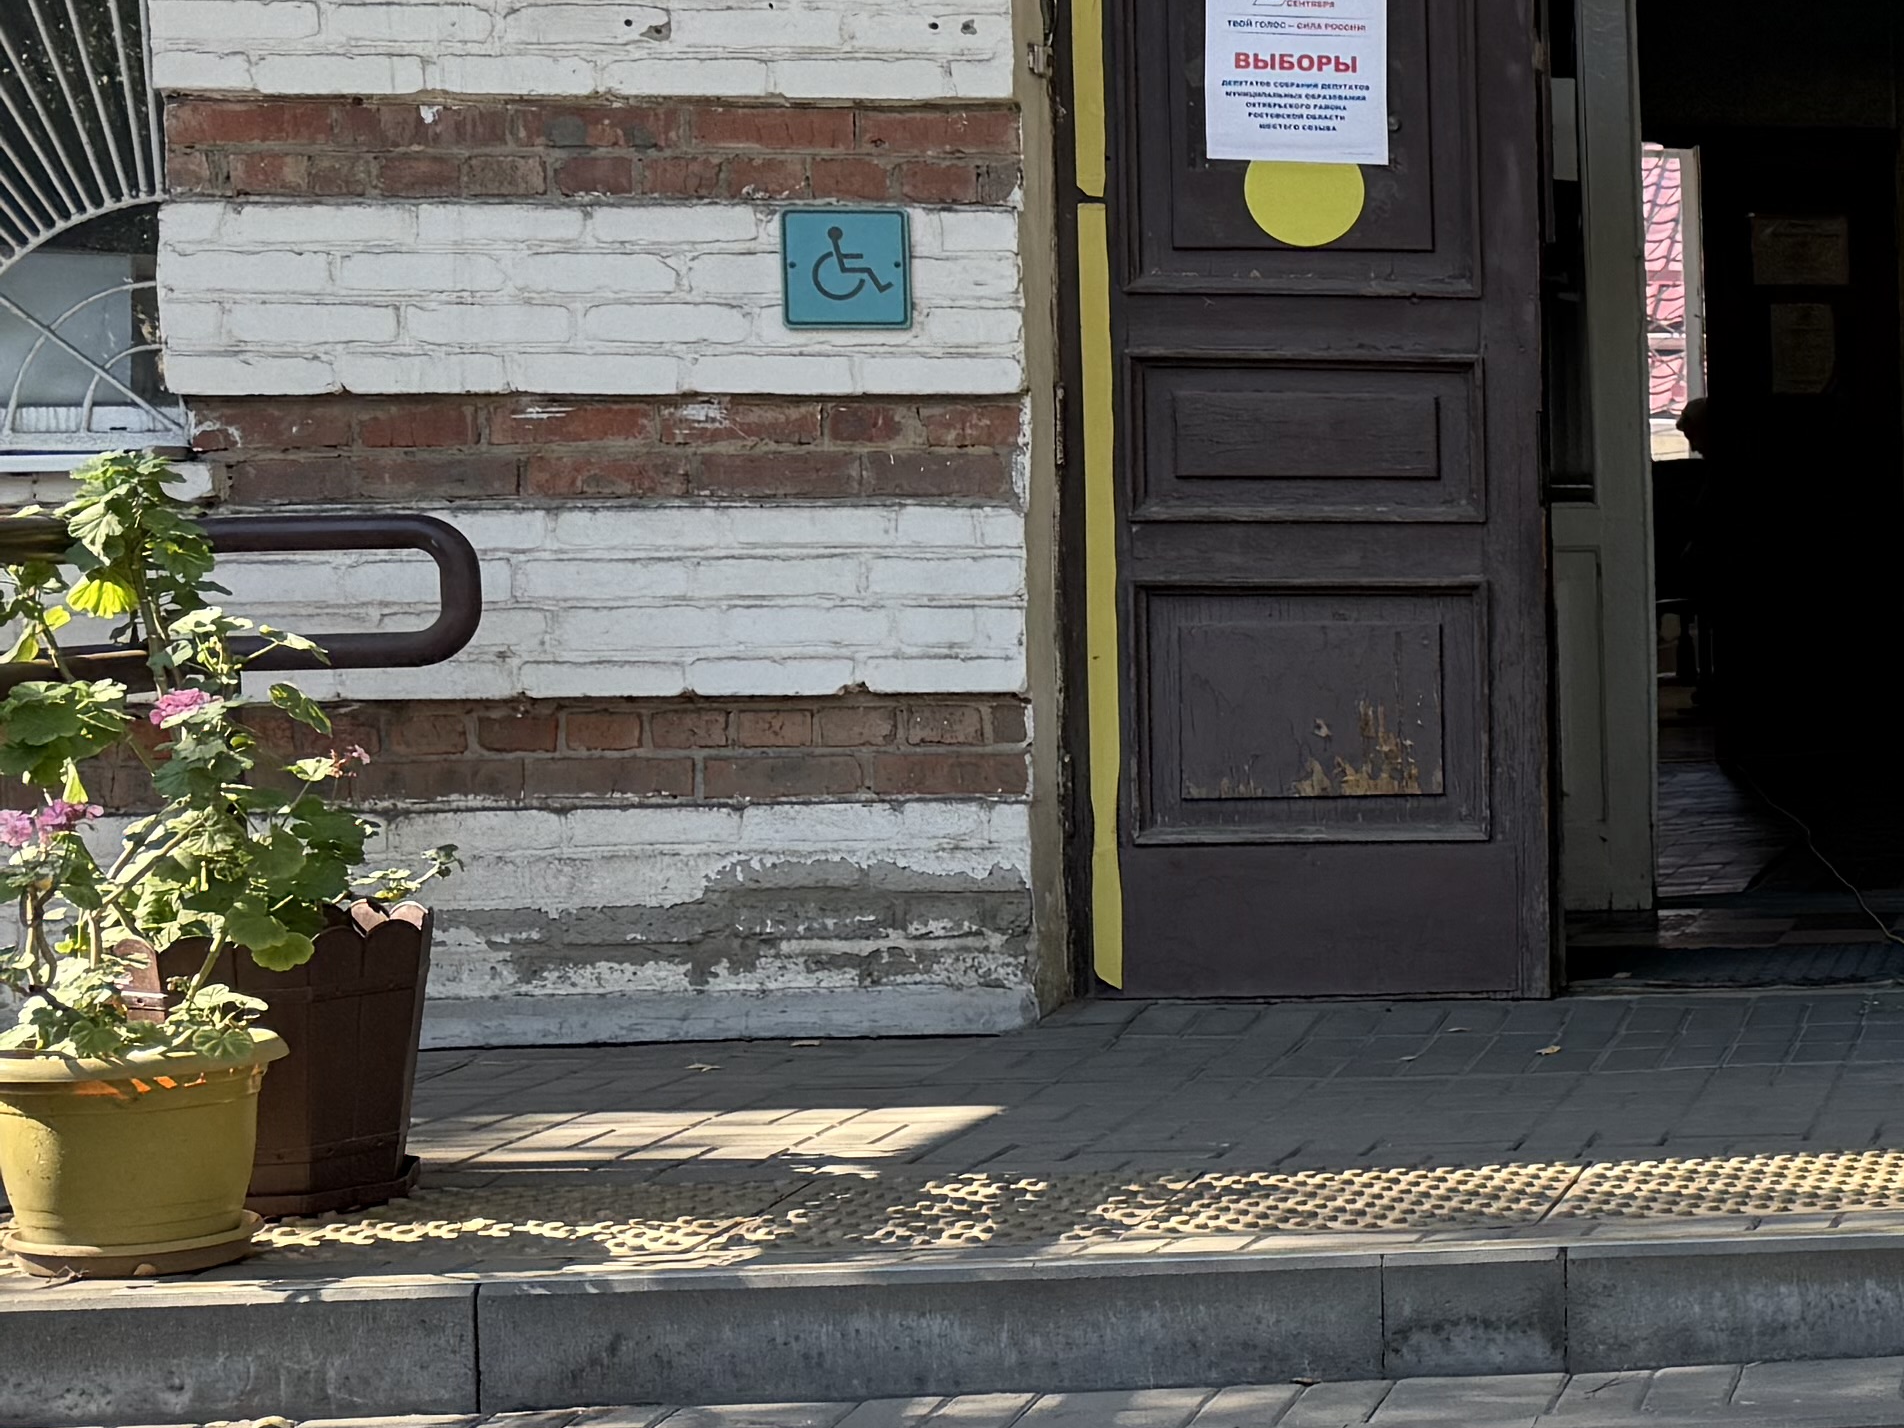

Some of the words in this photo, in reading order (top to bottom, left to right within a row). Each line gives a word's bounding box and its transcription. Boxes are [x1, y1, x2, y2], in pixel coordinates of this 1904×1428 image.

[1286, 0, 1335, 8] СЕНТЯБРЯ
[1227, 19, 1253, 28] ТВОЙ
[1254, 20, 1287, 29] ГОЛОС
[1296, 21, 1323, 31] СИЛА
[1234, 51, 1358, 74] ВЫБОРЫ
[1221, 79, 1271, 88] ДЕПУТАТОВ
[1320, 83, 1370, 92] ДЕПУТАТОВ
[1245, 101, 1311, 111] ОКТЯБРЬСКОГО
[1247, 111, 1304, 120] РОСТОВСКОЙ
[1305, 113, 1346, 121] ОБЛАСТИ
